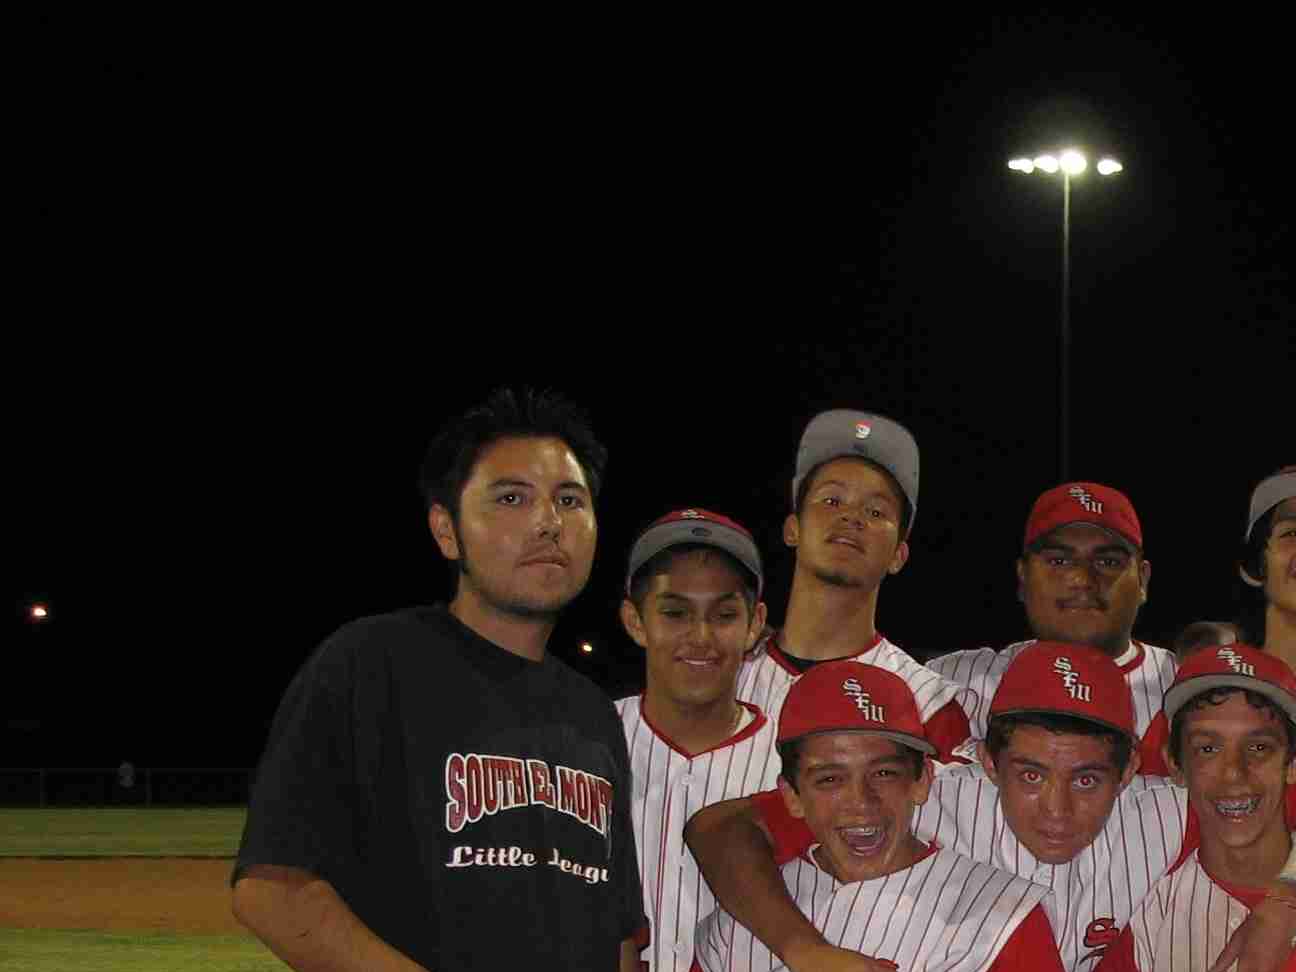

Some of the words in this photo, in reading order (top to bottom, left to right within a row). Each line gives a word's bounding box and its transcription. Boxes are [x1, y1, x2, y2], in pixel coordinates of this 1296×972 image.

[445, 752, 529, 833] SOUTH
[526, 758, 558, 810] EL
[445, 845, 538, 868] Little
